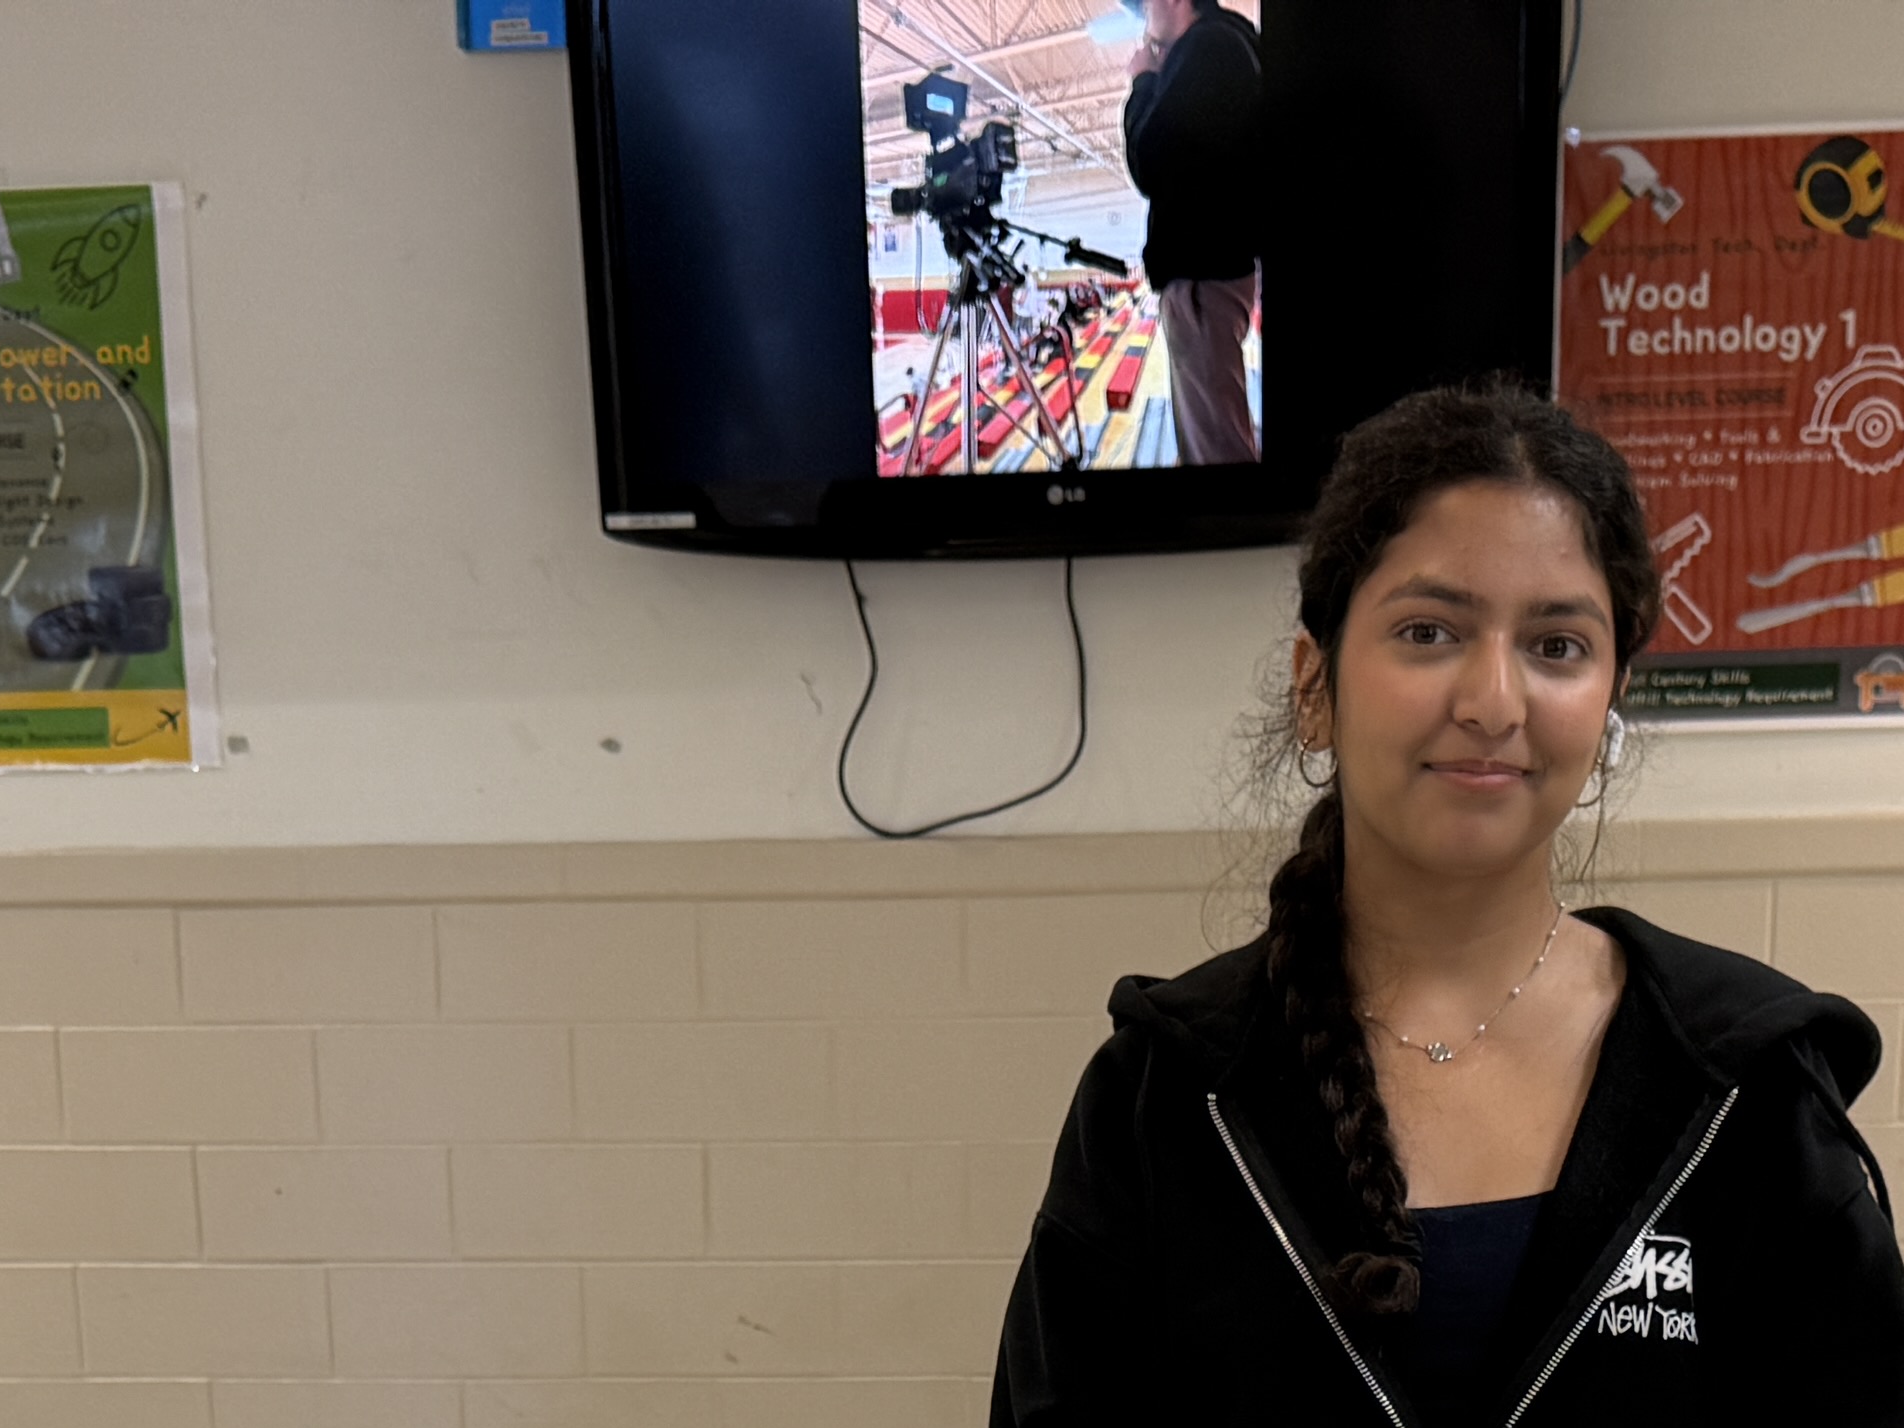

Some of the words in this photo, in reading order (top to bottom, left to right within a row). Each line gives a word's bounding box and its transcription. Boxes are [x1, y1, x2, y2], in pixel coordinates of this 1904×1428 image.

[1599, 268, 1711, 312] Wood
[96, 336, 152, 365] and
[1599, 314, 1827, 363] Technology
[1838, 308, 1858, 349] 1
